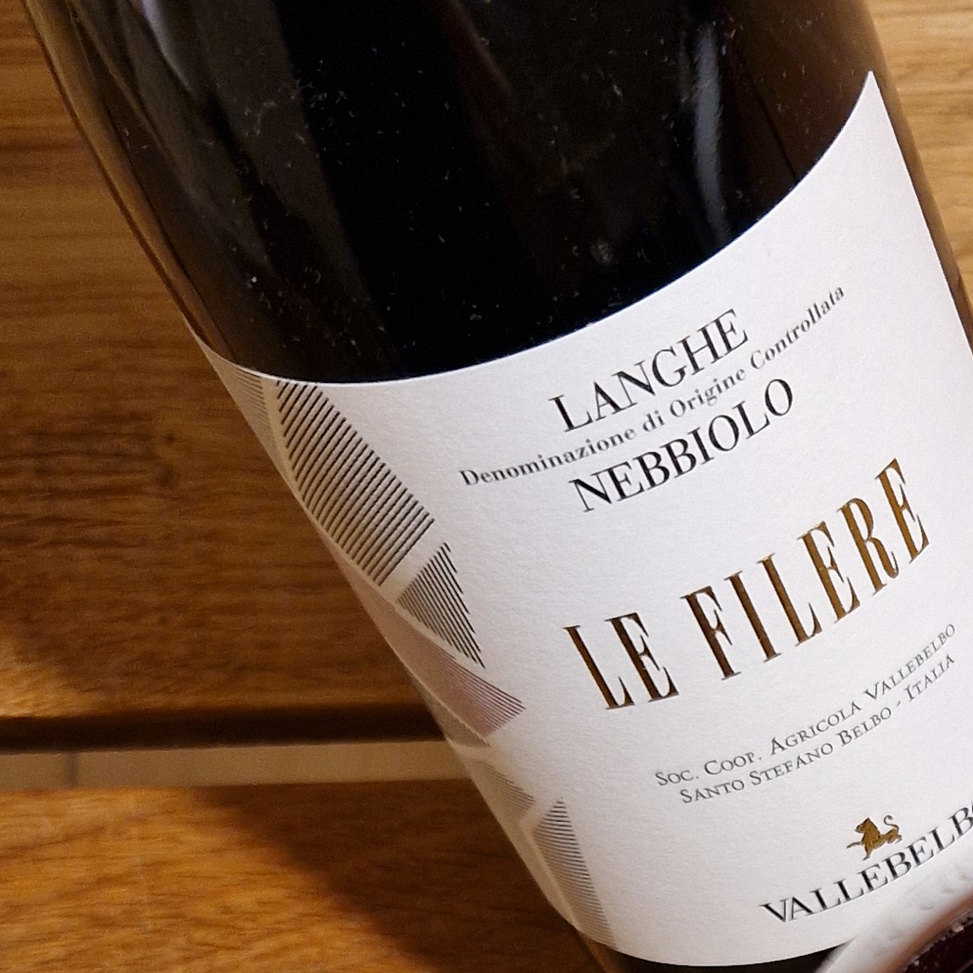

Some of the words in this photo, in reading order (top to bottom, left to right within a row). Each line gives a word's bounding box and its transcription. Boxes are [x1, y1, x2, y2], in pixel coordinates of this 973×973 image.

[459, 426, 637, 486] Denominazione
[642, 410, 666, 434] di
[669, 367, 747, 418] Origine
[749, 285, 846, 370] Controllata
[549, 308, 749, 433] LANGHE
[568, 377, 794, 513] NEBBIOLO
[562, 612, 680, 710] LE
[680, 458, 930, 681] FILERE
